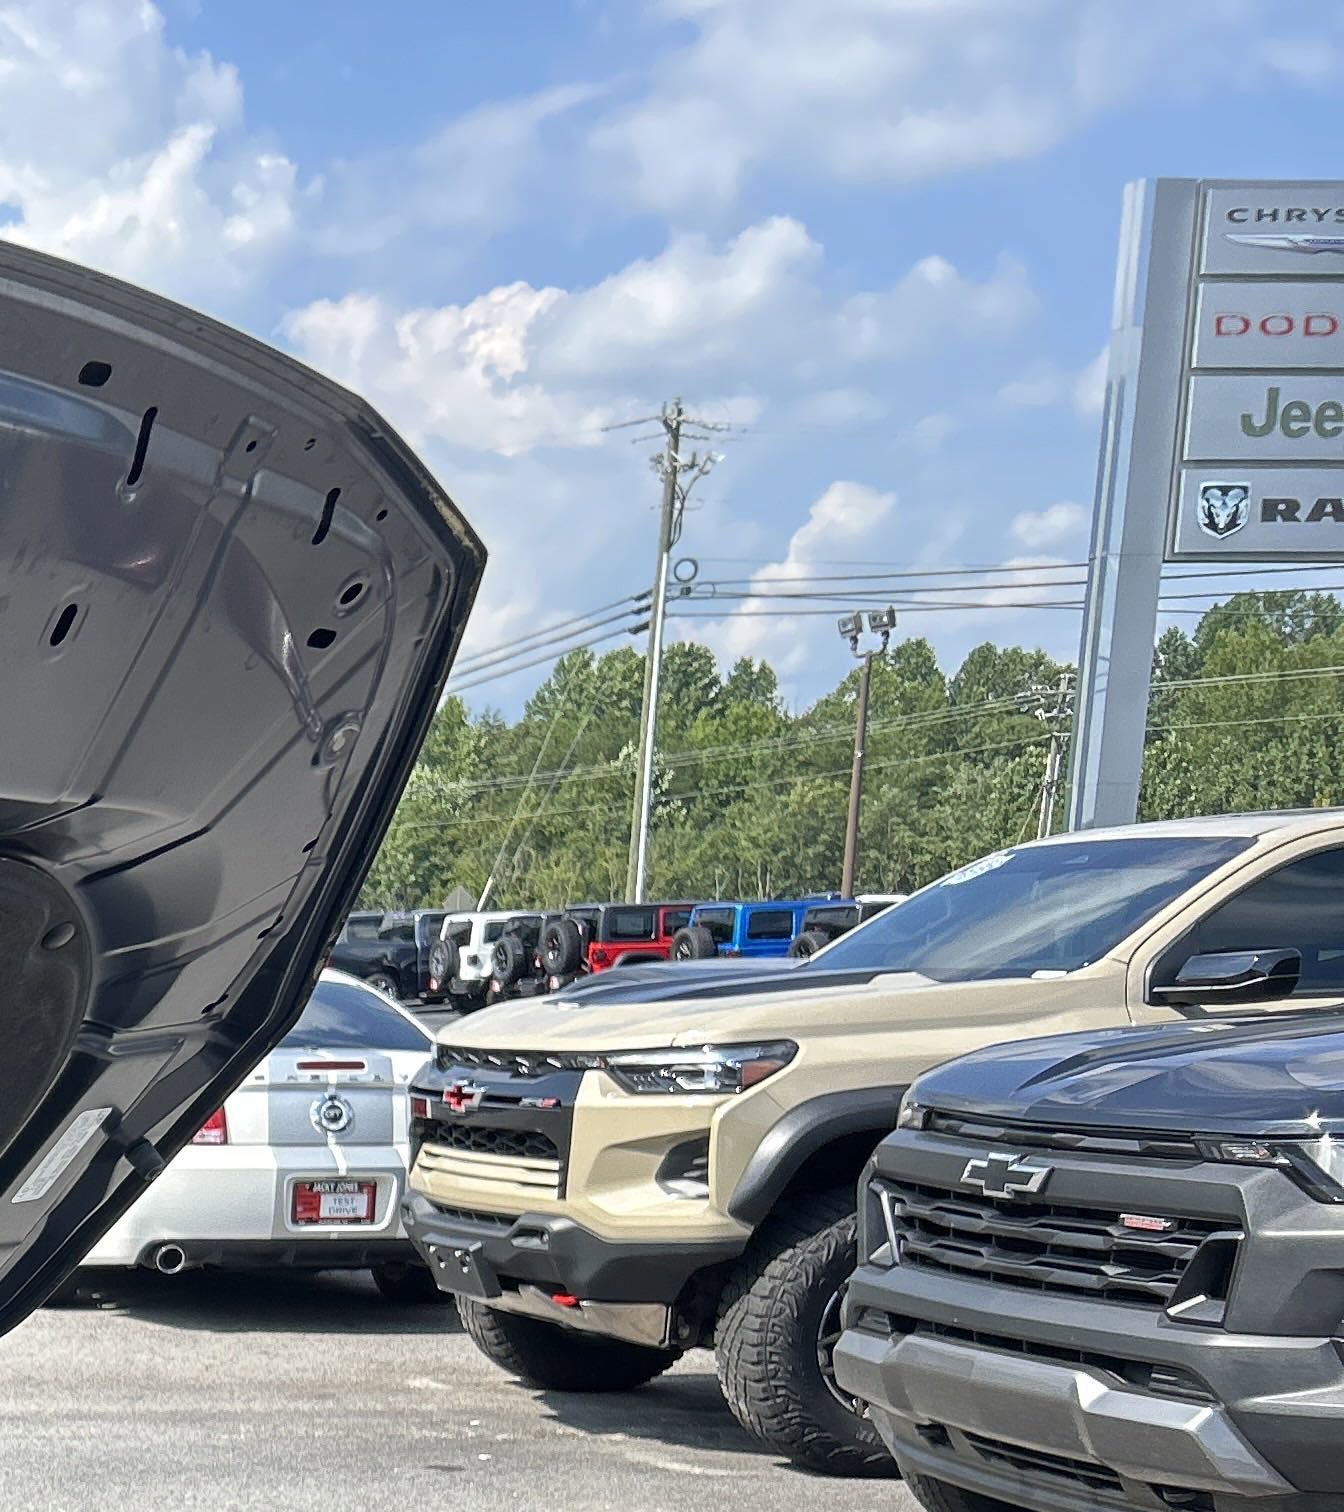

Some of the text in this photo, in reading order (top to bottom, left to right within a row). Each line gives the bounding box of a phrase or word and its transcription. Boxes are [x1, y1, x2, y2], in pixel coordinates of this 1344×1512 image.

[1215, 313, 1339, 337] DOD
[1241, 386, 1344, 438] Jee
[1261, 498, 1344, 522] RA
[328, 1206, 358, 1215] DRIVE
[333, 1197, 355, 1206] TEST
